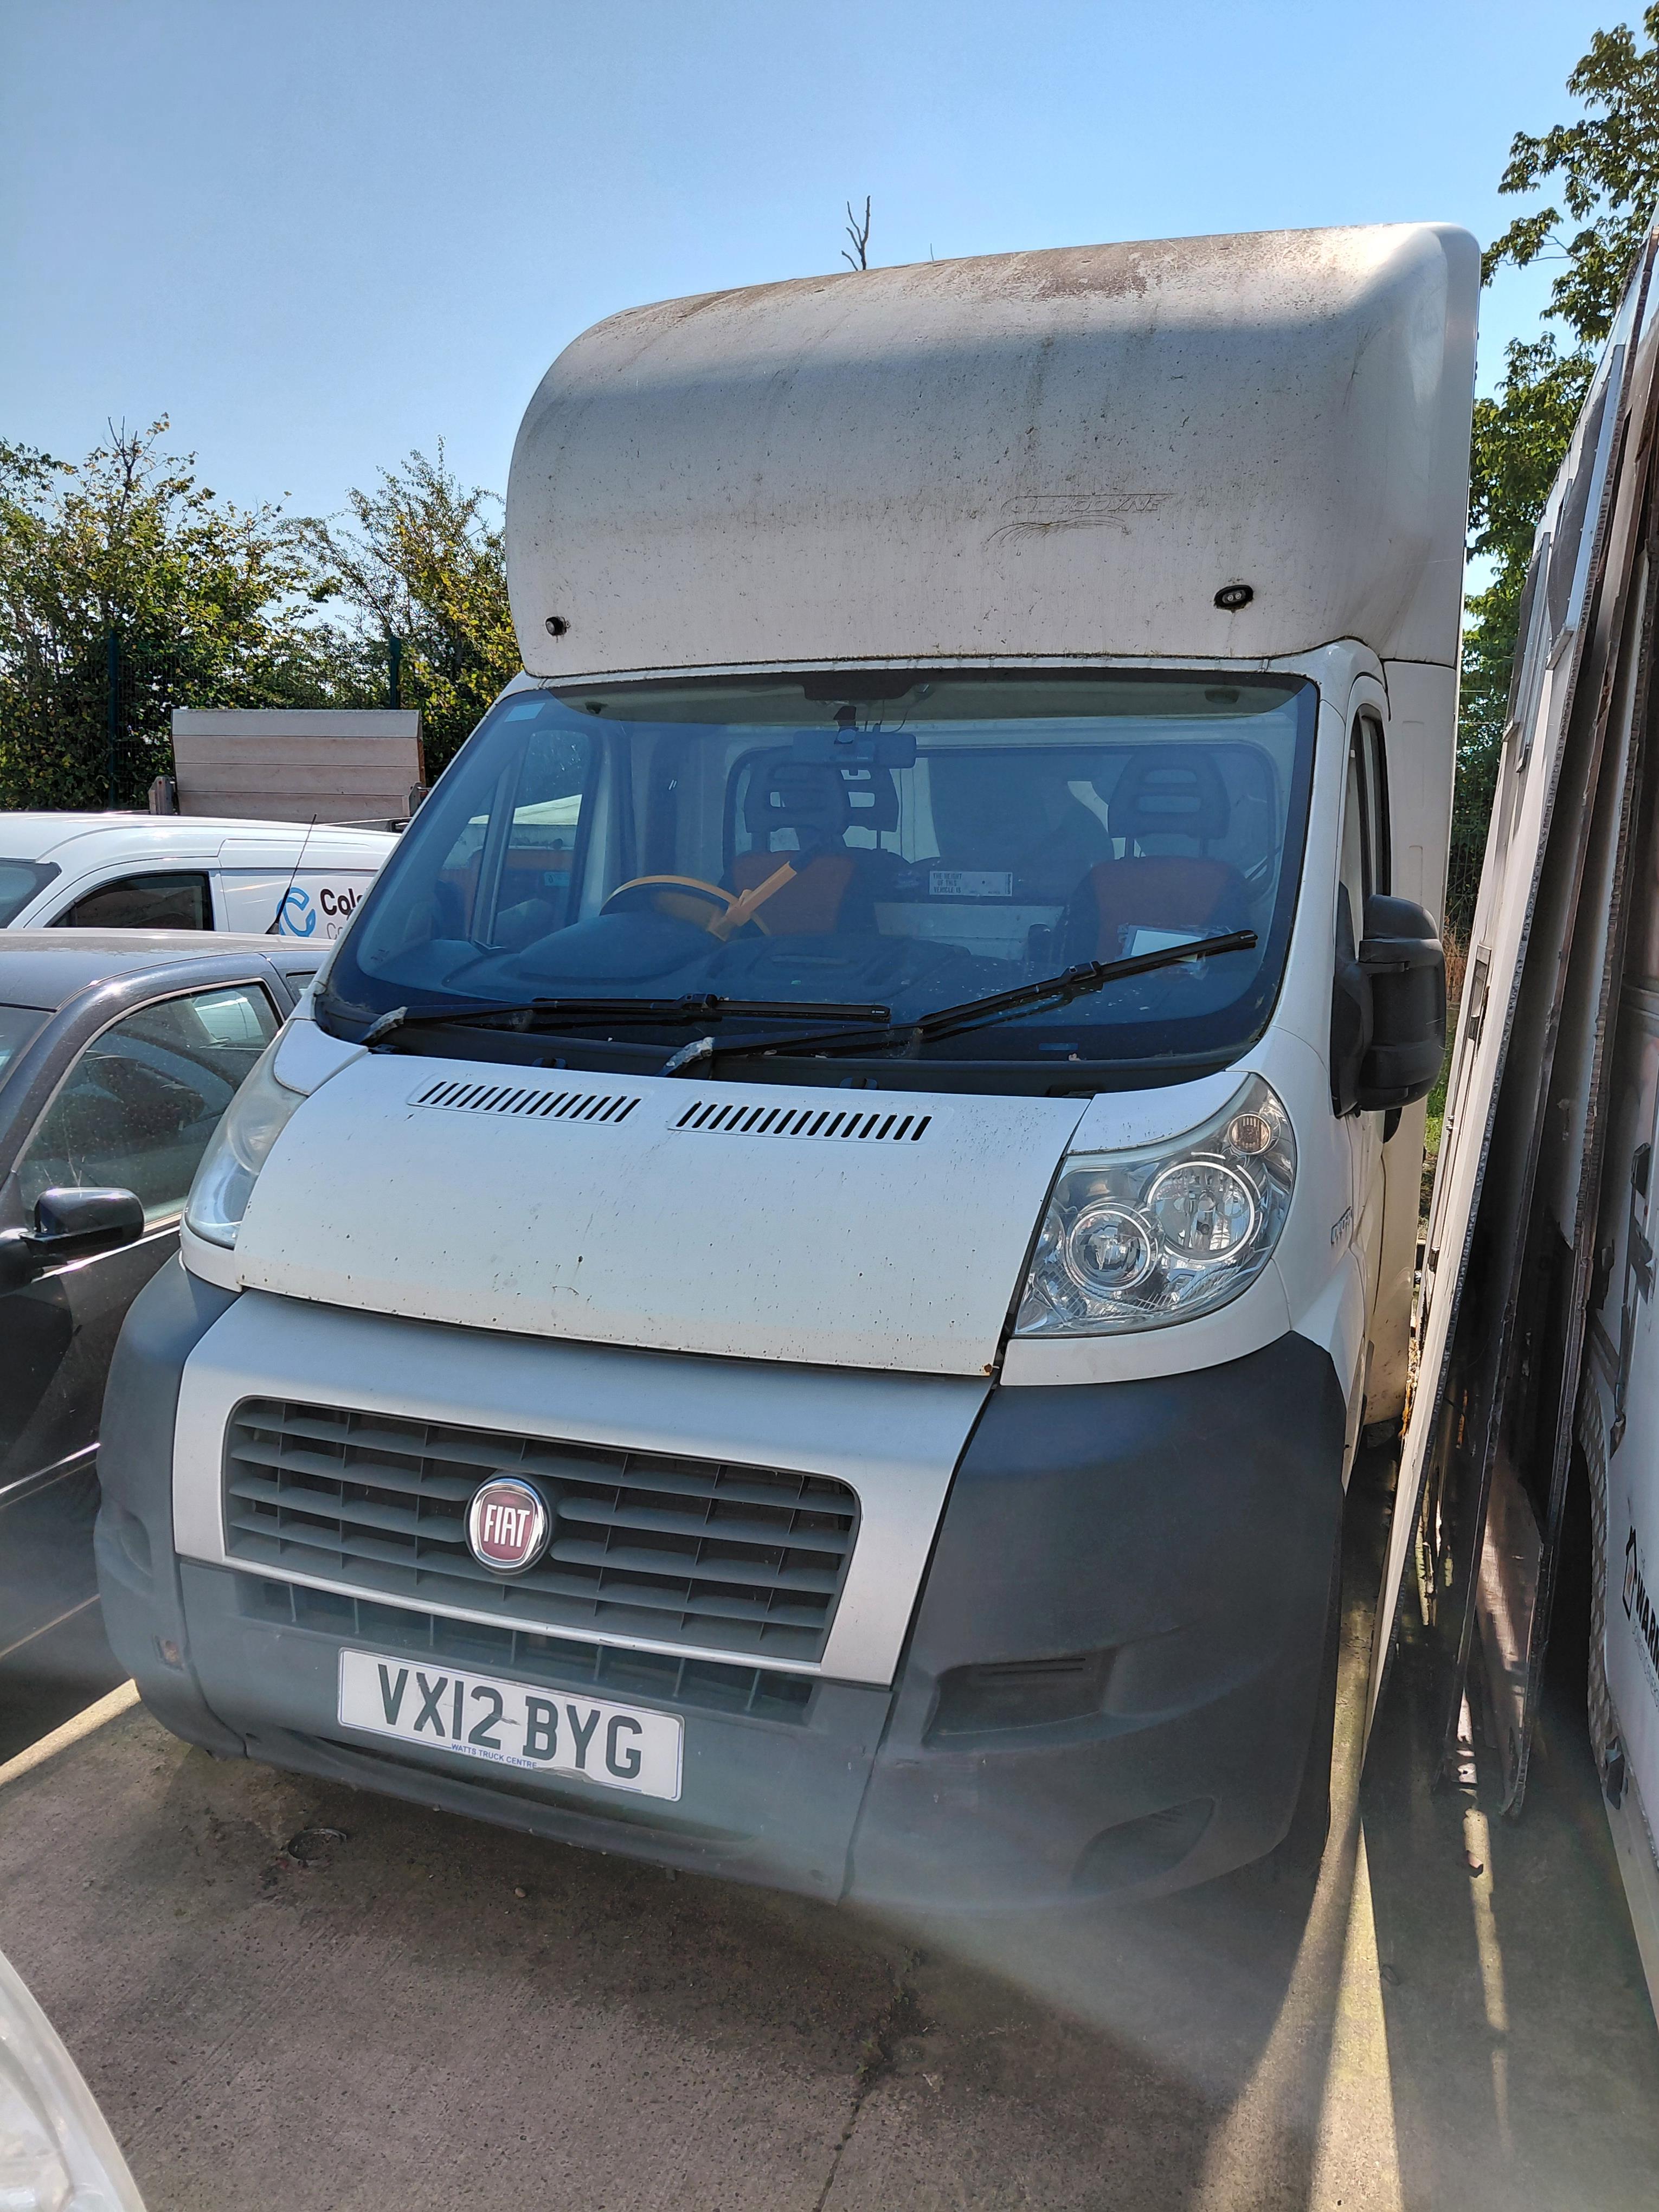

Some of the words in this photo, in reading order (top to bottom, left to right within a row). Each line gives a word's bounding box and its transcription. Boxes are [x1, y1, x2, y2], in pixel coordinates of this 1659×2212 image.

[484, 1504, 530, 1547] FIAT
[378, 1664, 503, 1750] VX12
[523, 1696, 643, 1779] BYG
[452, 1743, 477, 1755] WATTS
[479, 1750, 504, 1761] TRUCK
[506, 1756, 537, 1768] CENTRE
